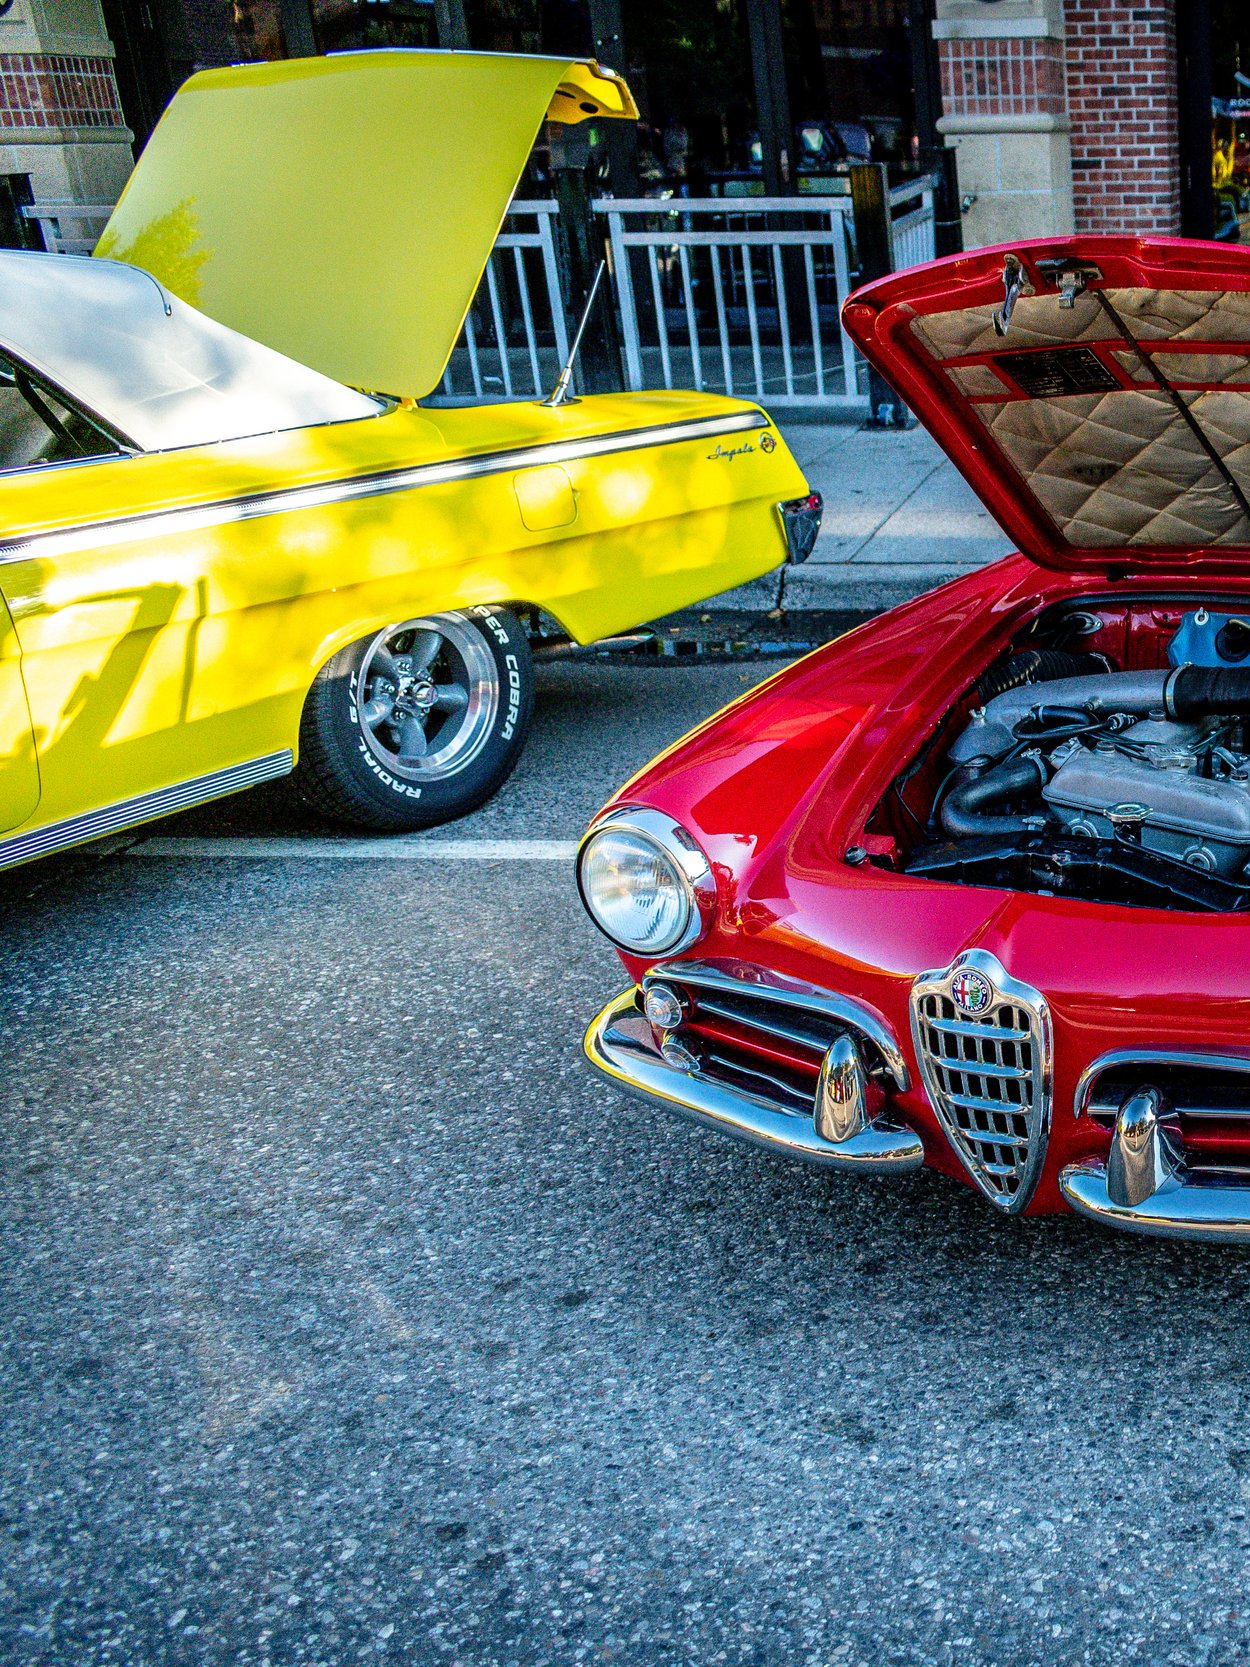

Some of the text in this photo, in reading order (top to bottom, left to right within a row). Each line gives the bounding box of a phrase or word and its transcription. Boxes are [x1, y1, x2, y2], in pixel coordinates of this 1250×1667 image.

[706, 443, 756, 462] Impala
[469, 605, 520, 741] PER COBRA
[349, 671, 422, 799] RADIAL G/T
[958, 1001, 983, 1011] MILANO
